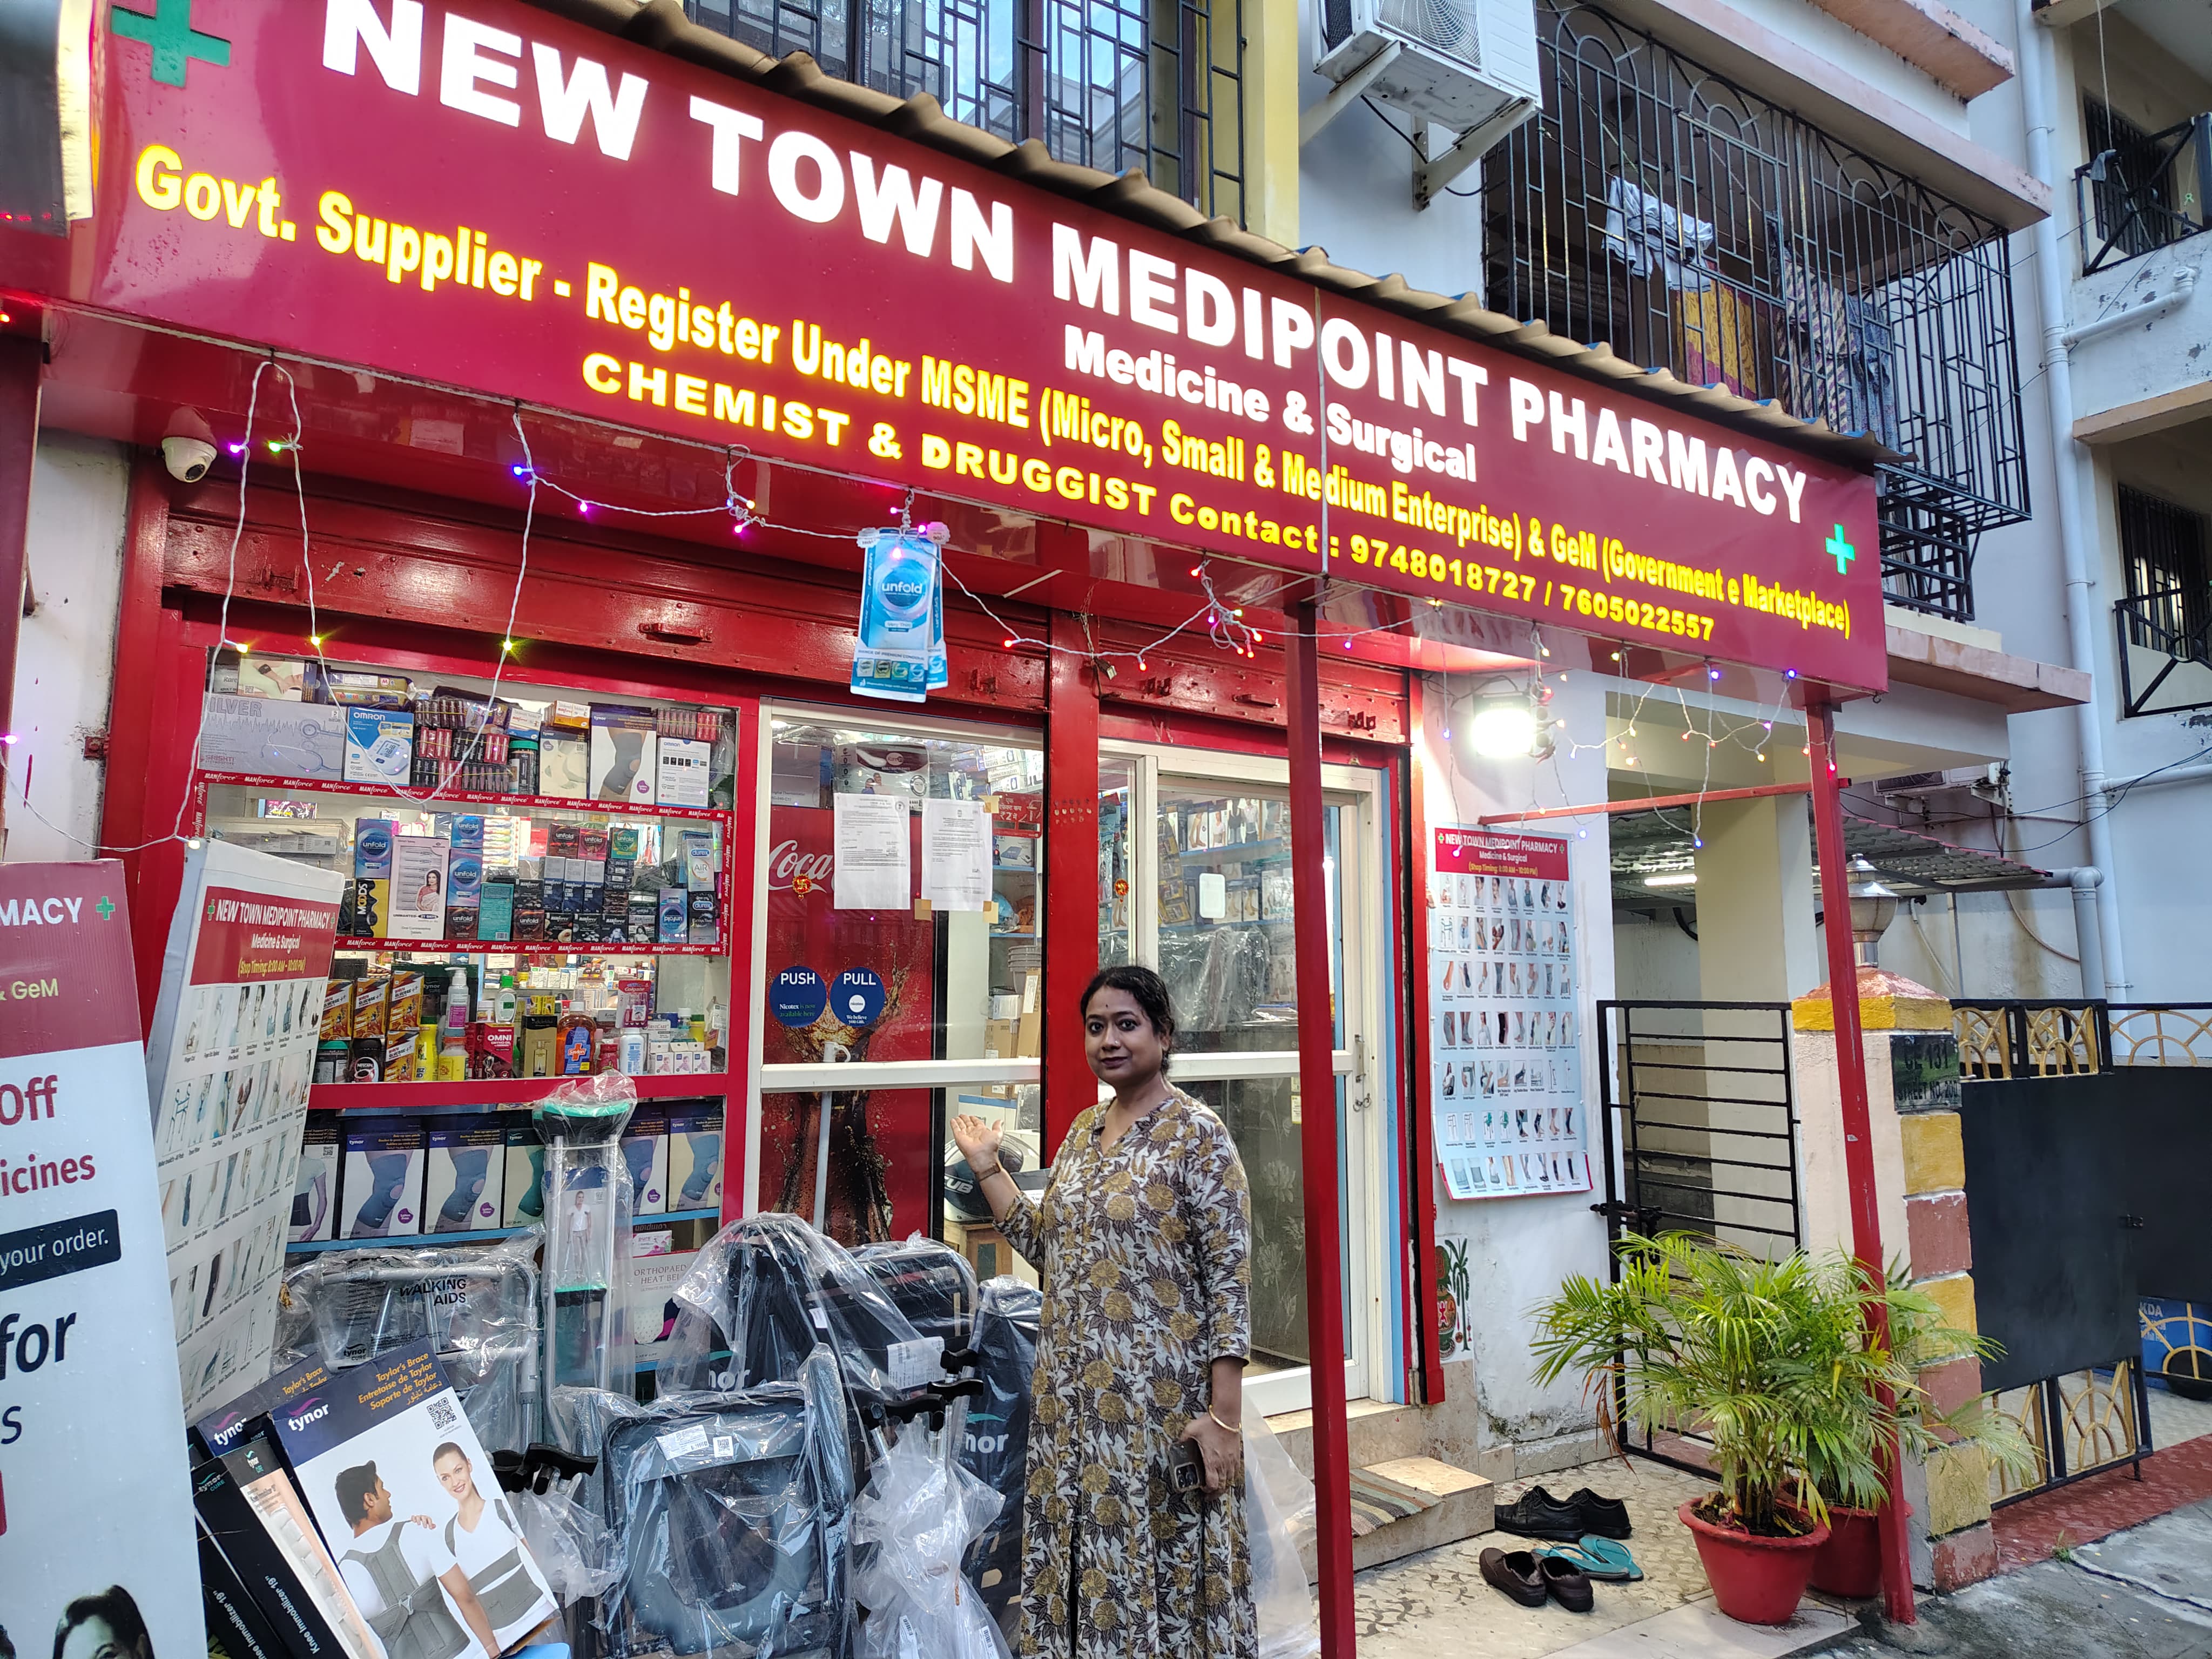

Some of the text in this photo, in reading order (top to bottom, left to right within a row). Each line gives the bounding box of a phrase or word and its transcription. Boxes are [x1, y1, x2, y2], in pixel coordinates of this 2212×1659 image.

[323, 0, 1806, 523] NEW TOWN MEDIPOINT PHARMACY
[136, 143, 296, 241] Govt.
[315, 190, 542, 302] Supplier
[585, 261, 781, 365] Register
[792, 319, 911, 397] Under
[920, 353, 1029, 429] MSME
[1038, 387, 1153, 469] (Micro,
[1162, 419, 1244, 481] Small
[1253, 444, 1275, 488] &
[1282, 449, 1387, 518] Medium
[1392, 481, 1521, 562] Enterprise)
[1528, 517, 1546, 557] &
[1550, 522, 1597, 571] GeM
[1602, 537, 1725, 603] (Government
[1728, 578, 1739, 601] e
[1743, 573, 1850, 640] Marketplace)
[1065, 324, 1477, 482] Medicine & Surgical
[582, 352, 850, 446] CHEMIST
[868, 422, 902, 460] &
[920, 433, 1157, 516] DRUGGIST
[1170, 493, 1318, 554] Contact
[1350, 534, 1536, 604] 9748018727
[1544, 582, 1552, 606] /
[1560, 585, 1715, 642] 7605022557
[881, 581, 922, 594] unfold
[354, 712, 386, 721] OMRON
[205, 772, 712, 818] MANforce MANforce MANforce MANforce MANforce MANforce MANforce MANforce MANforce MANforce MANforce MANforce MANforce
[1445, 833, 1462, 845] NEW
[1463, 835, 1484, 847] TOWN
[1521, 839, 1558, 853] PHARMACY
[768, 840, 833, 881] Coca
[1479, 851, 1527, 864] Medicine Surgical
[357, 882, 368, 914] MOODS
[0, 897, 83, 926] MACY
[216, 899, 331, 929] NEW TOWN MEDIPOINT PHARMACY
[251, 932, 276, 949] Medicine
[280, 934, 301, 954] Surgical
[347, 939, 377, 948] MANforce
[384, 941, 414, 949] MANforce
[421, 942, 450, 950] MANforce
[456, 943, 485, 952] MANforce
[525, 945, 552, 953] MANforce
[558, 945, 585, 953] MANforce
[590, 945, 617, 953] MANforce
[11, 977, 59, 1000] GeM
[780, 973, 815, 985] PUSH
[843, 973, 876, 986] PULL
[0, 1075, 58, 1126] Off
[0, 1154, 96, 1197] icines
[0, 1227, 109, 1276] your order.
[400, 1278, 467, 1297] WALKING
[640, 1275, 664, 1285] HEAT
[433, 1292, 466, 1306] AIDS
[0, 1312, 76, 1380] for
[343, 1348, 366, 1357] tynor
[306, 1366, 323, 1380] Brace
[376, 1352, 429, 1382] Taylor's Brace
[398, 1374, 408, 1384] de
[409, 1361, 433, 1378] Taylor
[370, 1372, 437, 1411] Soporte de Taylor
[288, 1403, 329, 1432] tynor
[198, 1474, 221, 1492] tynor
[210, 1479, 225, 1492] CURE
[275, 1587, 307, 1634] Immobilizer
[224, 1602, 256, 1648] Immobilizer
[304, 1632, 320, 1655] Knee
